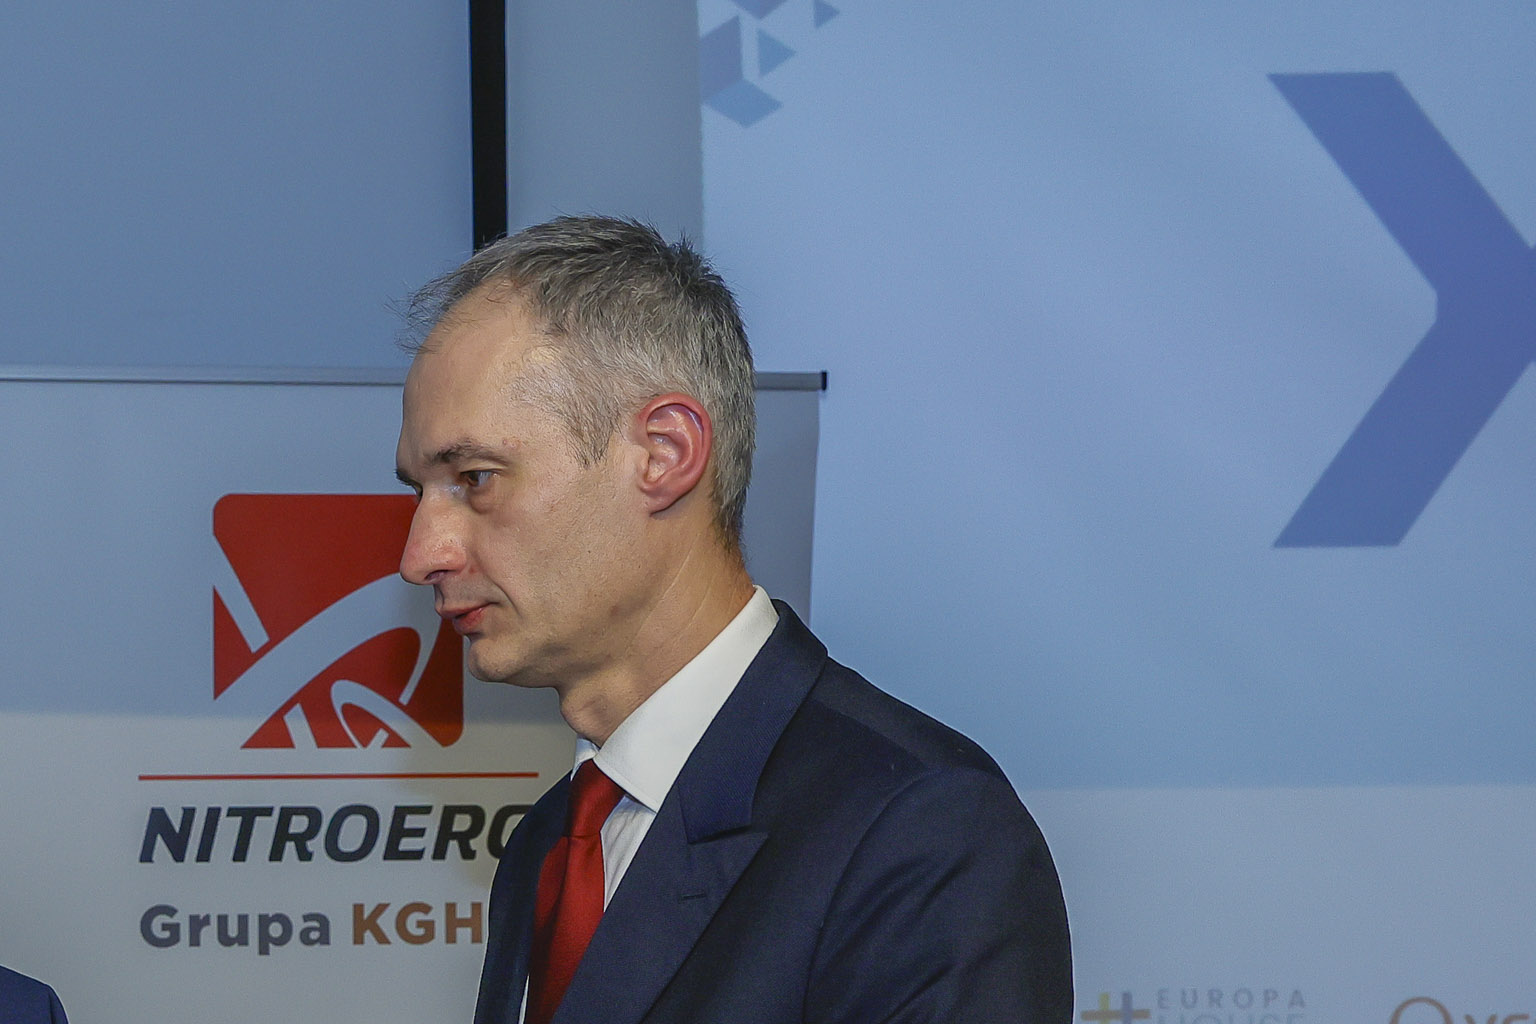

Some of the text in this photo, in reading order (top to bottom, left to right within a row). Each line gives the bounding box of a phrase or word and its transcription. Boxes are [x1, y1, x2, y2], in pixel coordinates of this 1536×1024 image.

[139, 901, 483, 955] Grupa KGH
[1157, 987, 1306, 1009] EUROPA
